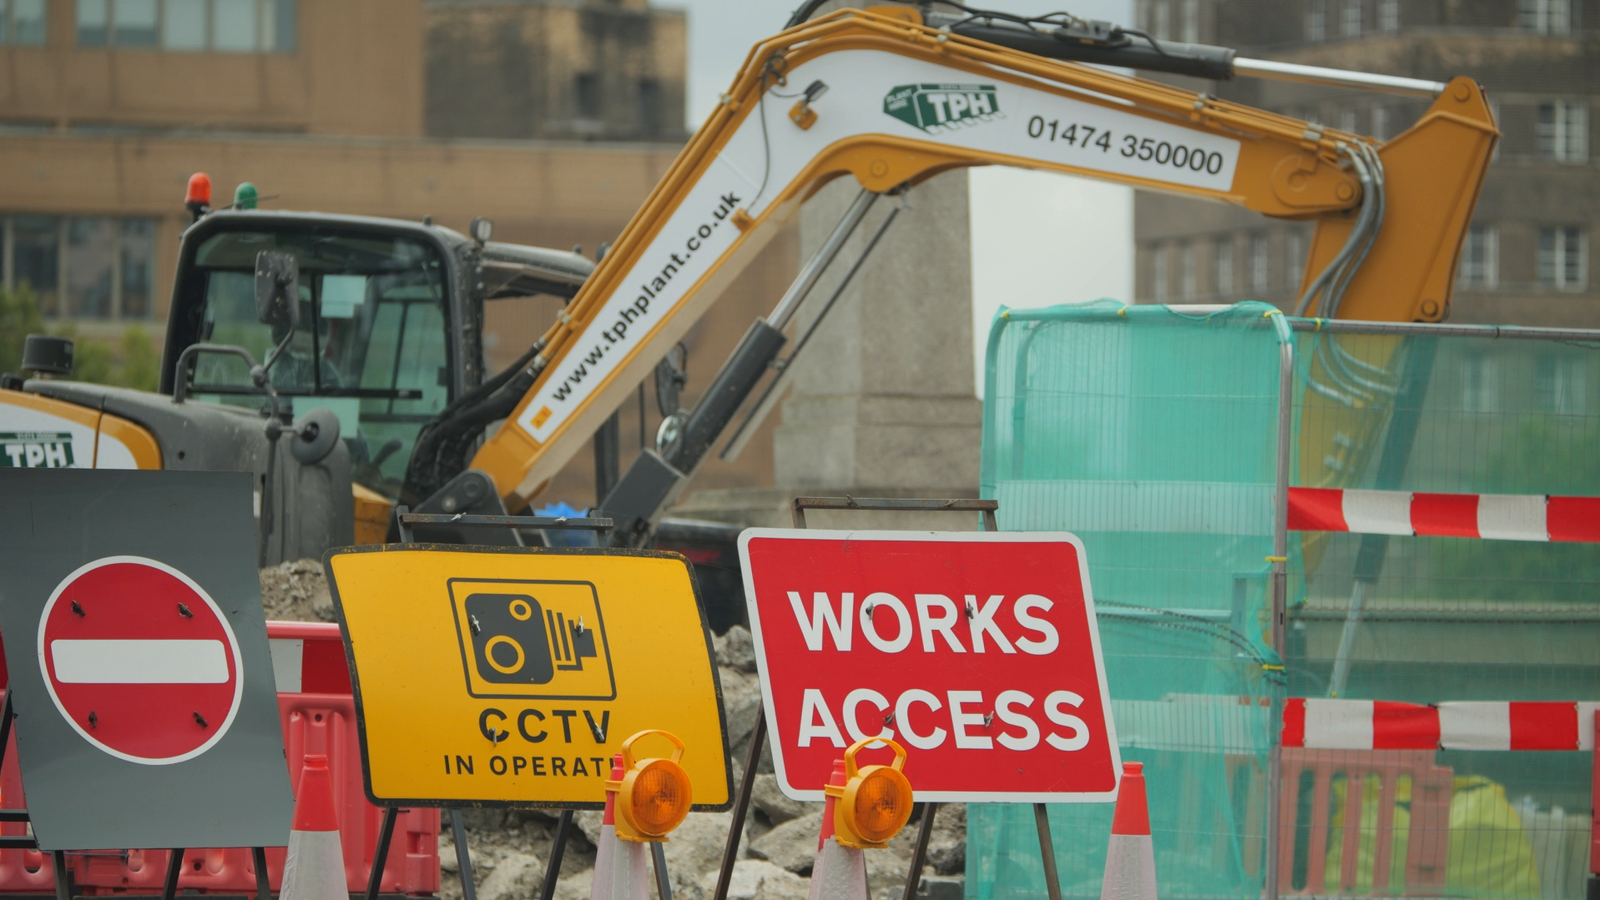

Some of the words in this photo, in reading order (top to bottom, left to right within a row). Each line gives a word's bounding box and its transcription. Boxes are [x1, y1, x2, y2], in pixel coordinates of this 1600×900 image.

[927, 92, 993, 123] TPH
[1027, 115, 1112, 153] 01474
[1120, 135, 1223, 175] 350000
[552, 190, 742, 402] www.tphplant.co.uk
[5, 443, 68, 468] TPH
[786, 591, 1060, 656] WORKS
[478, 707, 611, 745] CCTV
[797, 688, 1090, 752] ACCESS
[443, 754, 475, 775] IN
